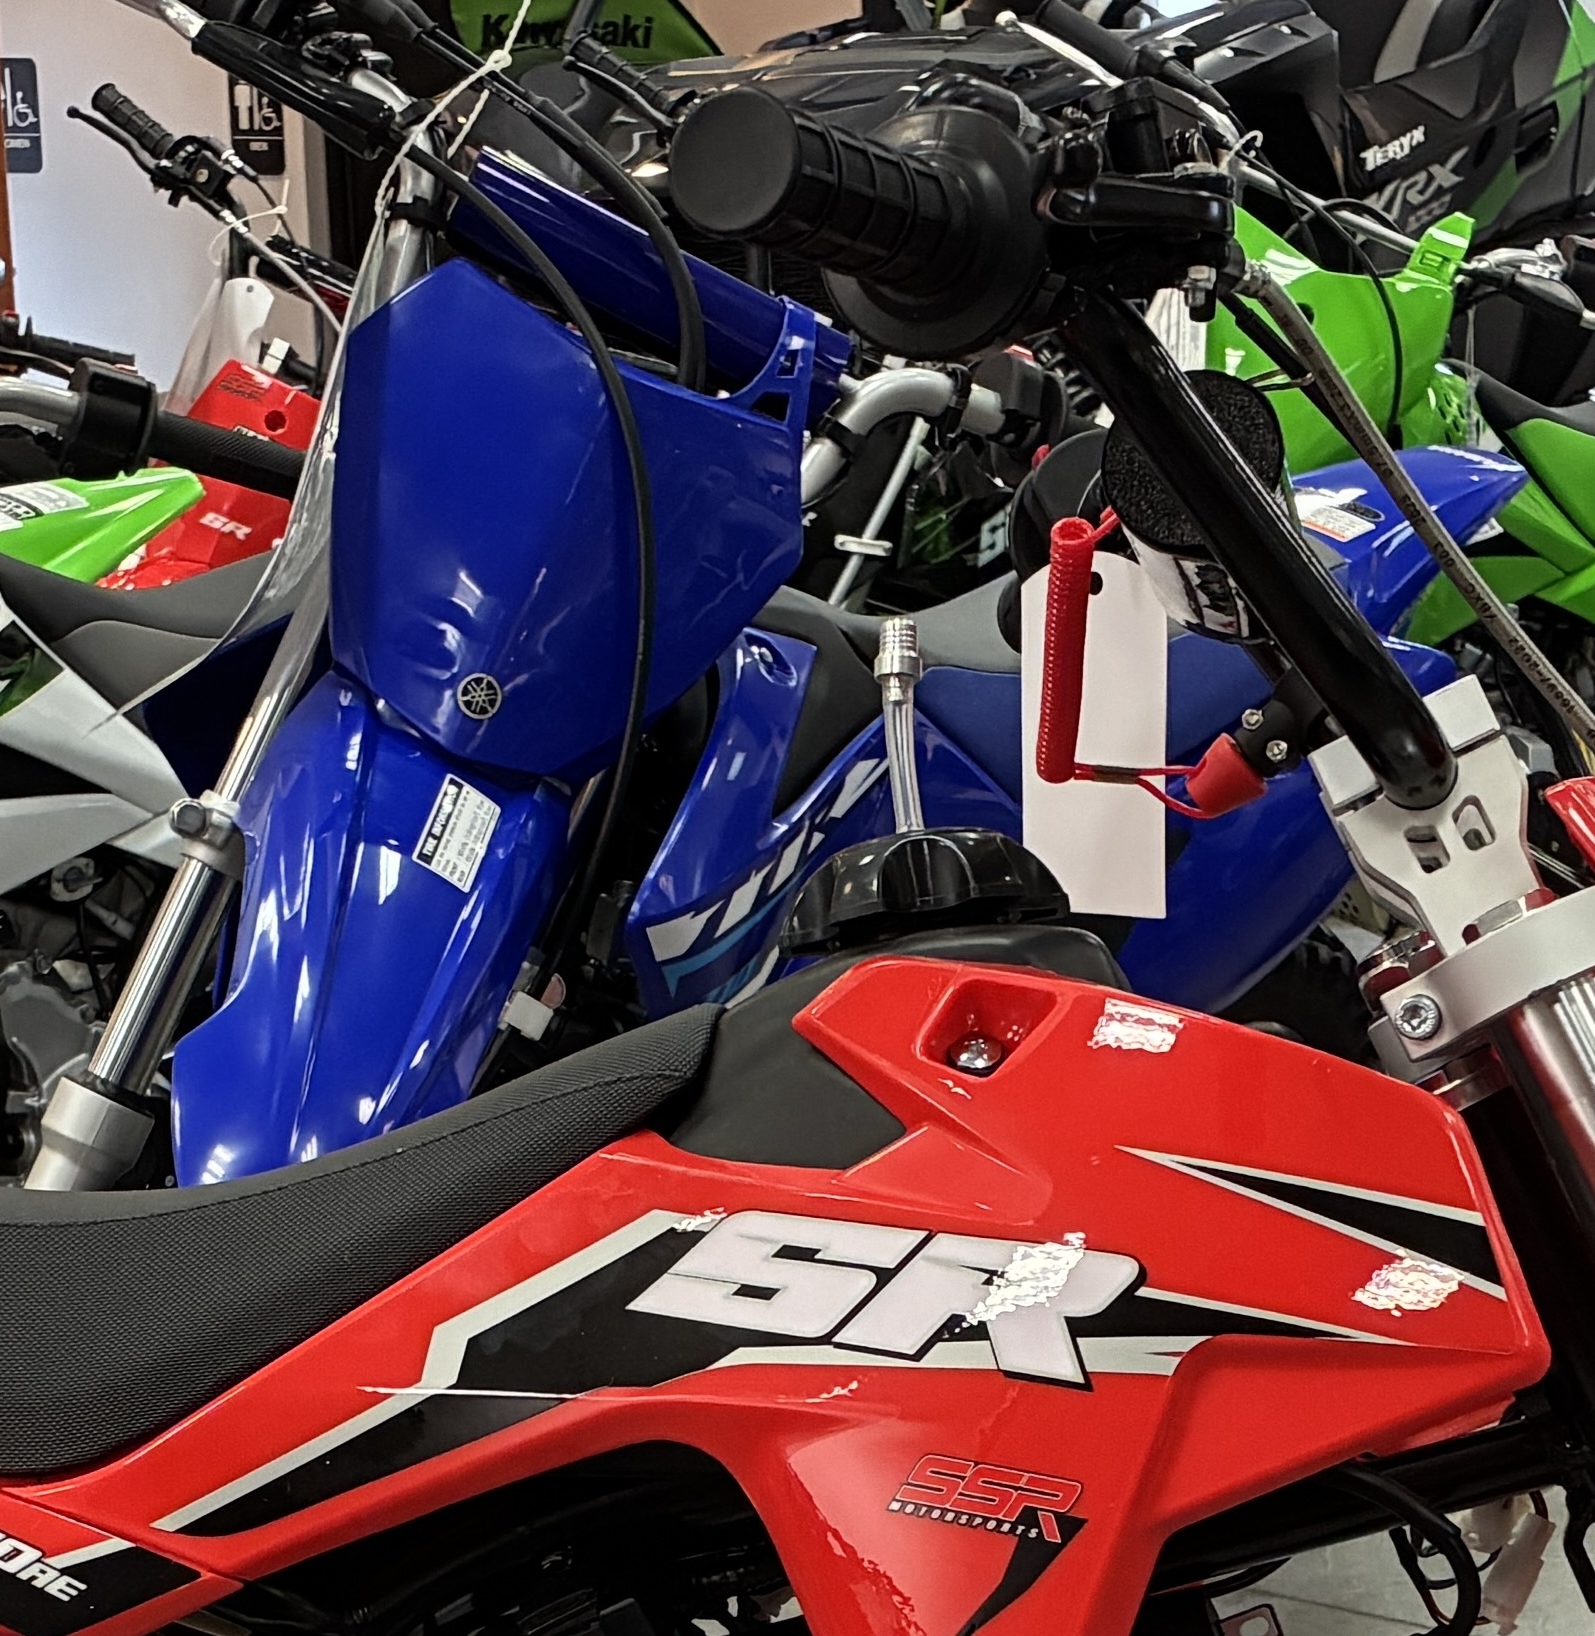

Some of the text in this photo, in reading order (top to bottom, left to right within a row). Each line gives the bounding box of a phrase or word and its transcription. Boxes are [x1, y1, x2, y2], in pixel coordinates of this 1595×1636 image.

[481, 14, 654, 49] Kawaki
[624, 1209, 1147, 1391] SR
[888, 1500, 1039, 1539] MOTORSPORTS
[894, 1453, 1083, 1543] SSR
